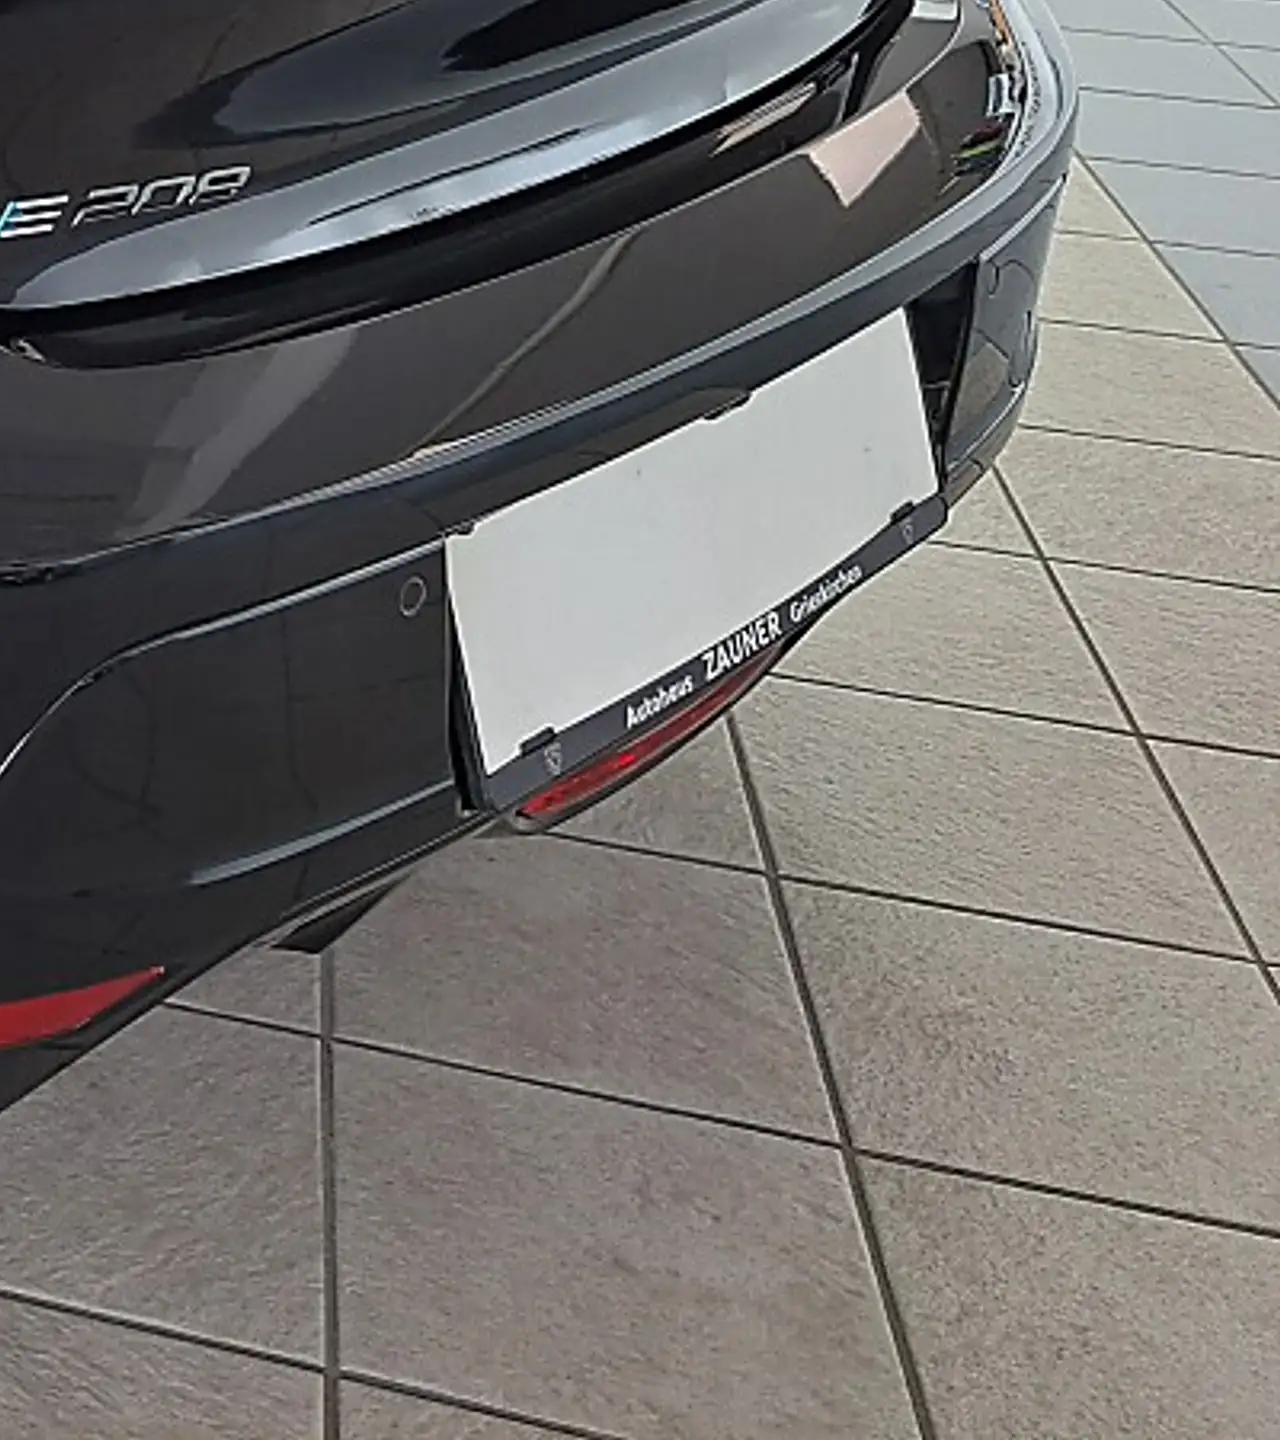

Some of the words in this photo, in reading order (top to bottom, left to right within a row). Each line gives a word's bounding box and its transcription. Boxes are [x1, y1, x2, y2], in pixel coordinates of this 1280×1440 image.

[71, 165, 252, 228] 208
[625, 674, 695, 730] Autohaus
[700, 610, 783, 682] ZAUNER
